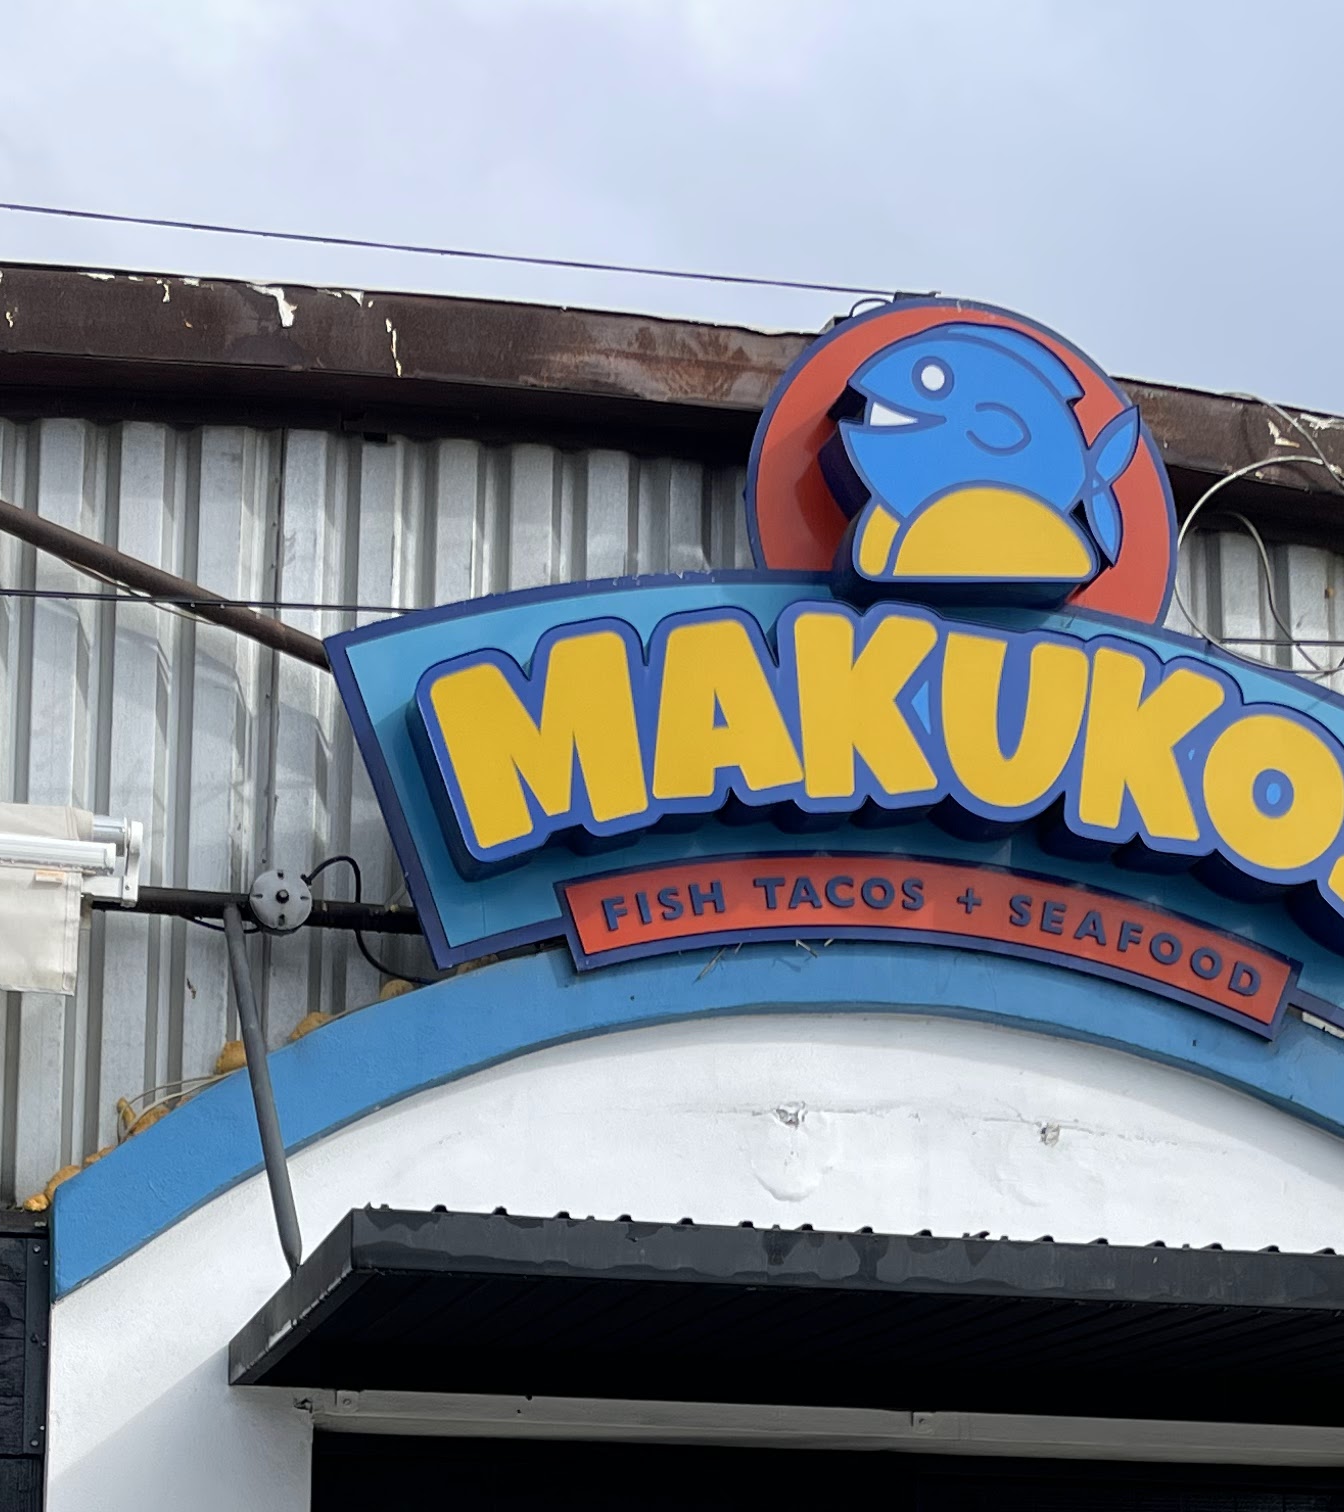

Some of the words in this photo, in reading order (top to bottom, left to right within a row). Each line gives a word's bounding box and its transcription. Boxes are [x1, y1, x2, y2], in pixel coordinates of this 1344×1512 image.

[601, 878, 727, 932] FISH
[753, 875, 925, 911] TACOS
[1008, 894, 1263, 997] SEAFOOD
